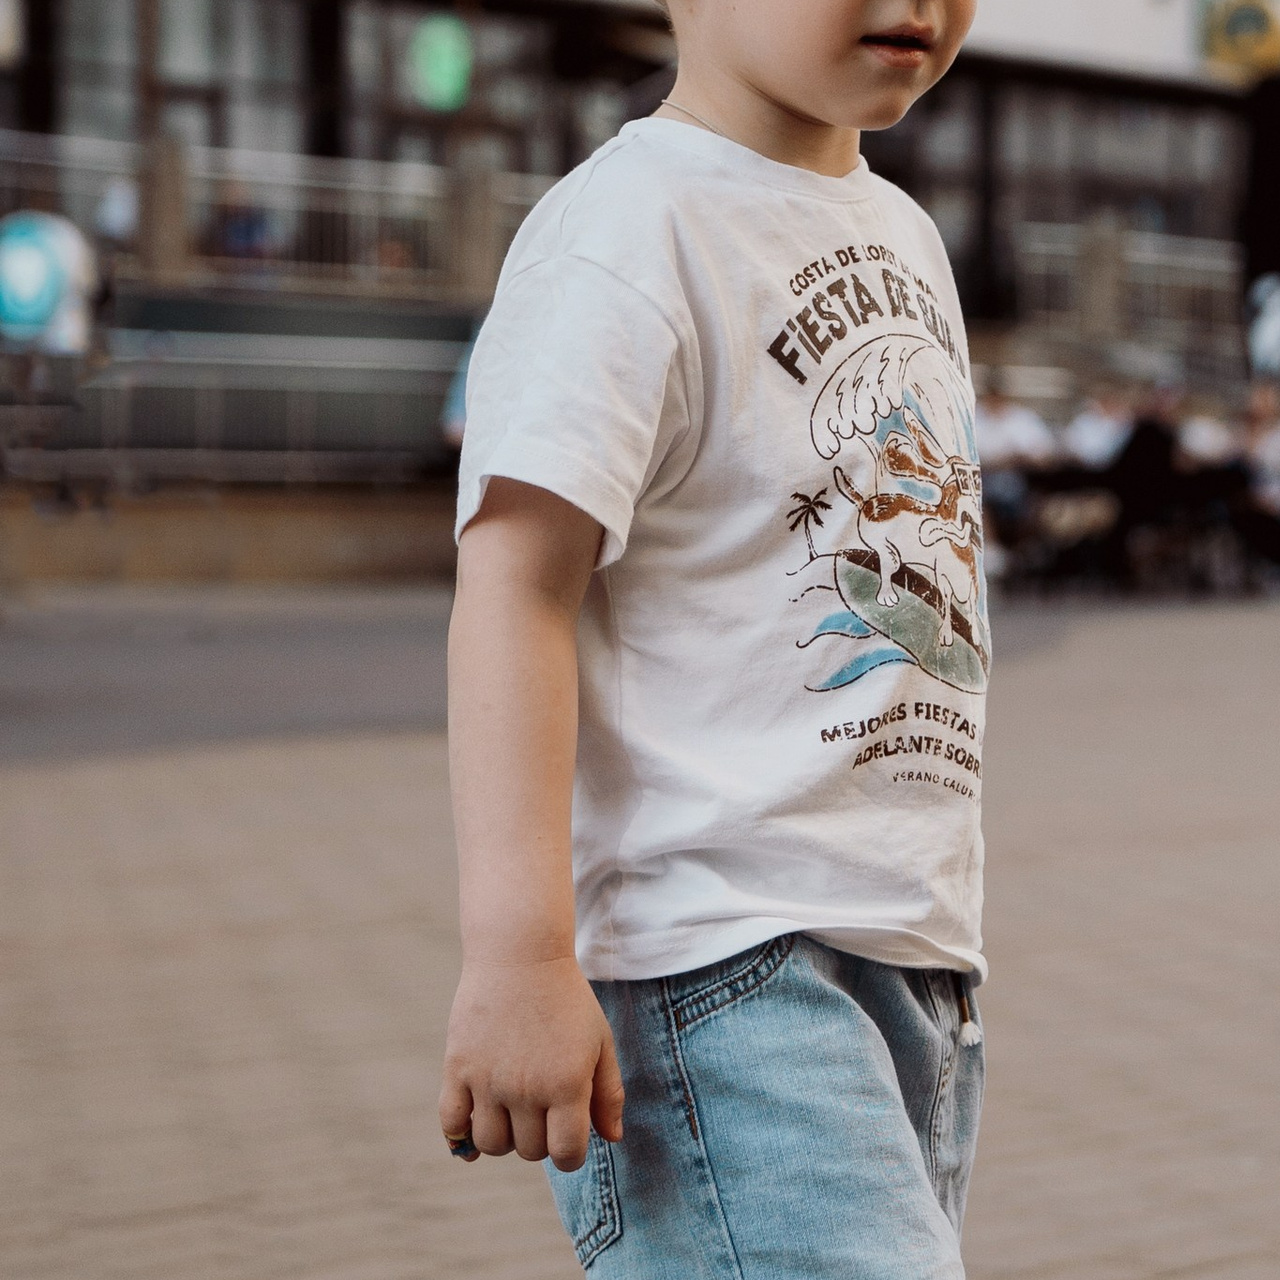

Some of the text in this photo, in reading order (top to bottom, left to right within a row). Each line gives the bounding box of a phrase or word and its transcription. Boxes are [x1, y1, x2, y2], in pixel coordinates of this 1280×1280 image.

[790, 257, 836, 296] COSTA
[834, 246, 861, 267] DE
[766, 274, 884, 385] FIESTA
[881, 268, 918, 320] DE
[820, 702, 977, 743] MEJORES FIESTAS
[852, 735, 981, 779] ADELANTE SOBR
[893, 771, 976, 802] VERANO CALUR
